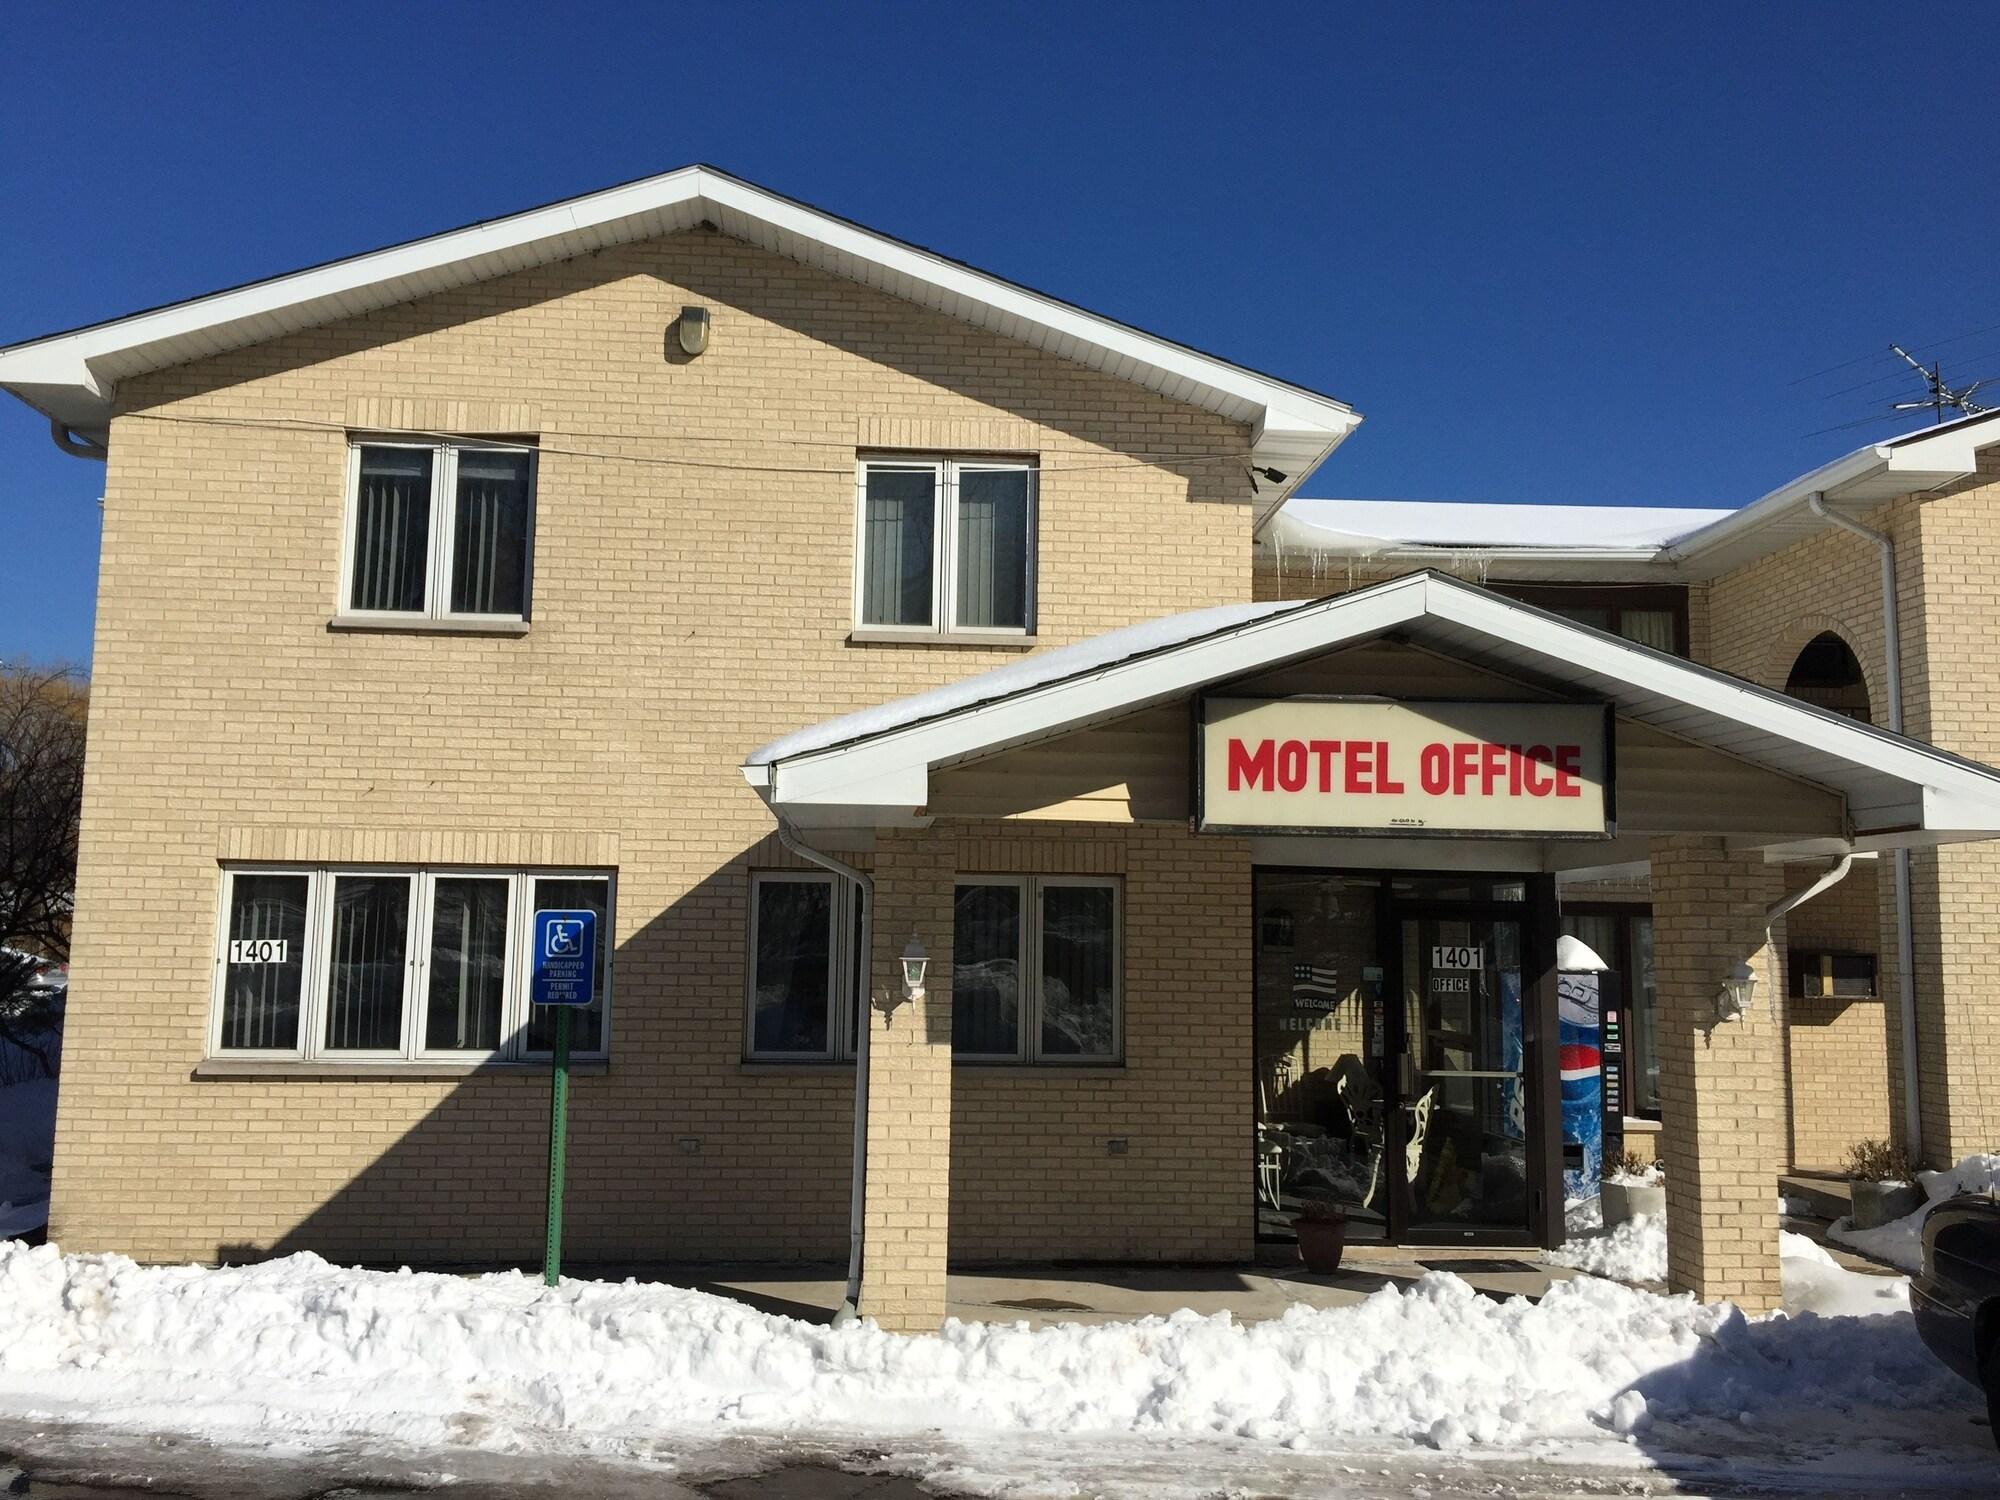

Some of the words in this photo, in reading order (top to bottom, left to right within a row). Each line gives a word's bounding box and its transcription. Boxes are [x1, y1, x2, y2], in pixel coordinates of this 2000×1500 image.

[1227, 738, 1405, 795] MOTEL
[1420, 742, 1582, 798] OFFICE
[234, 940, 284, 962] 1401
[1434, 947, 1481, 969] 1401
[542, 960, 585, 970] HANDICAPPED
[549, 969, 577, 978] PARKING
[550, 982, 574, 991] PERMIT
[1433, 978, 1468, 991] OFFICE
[1294, 998, 1336, 1010] WELCOME
[1279, 1017, 1342, 1031] WELCOME
